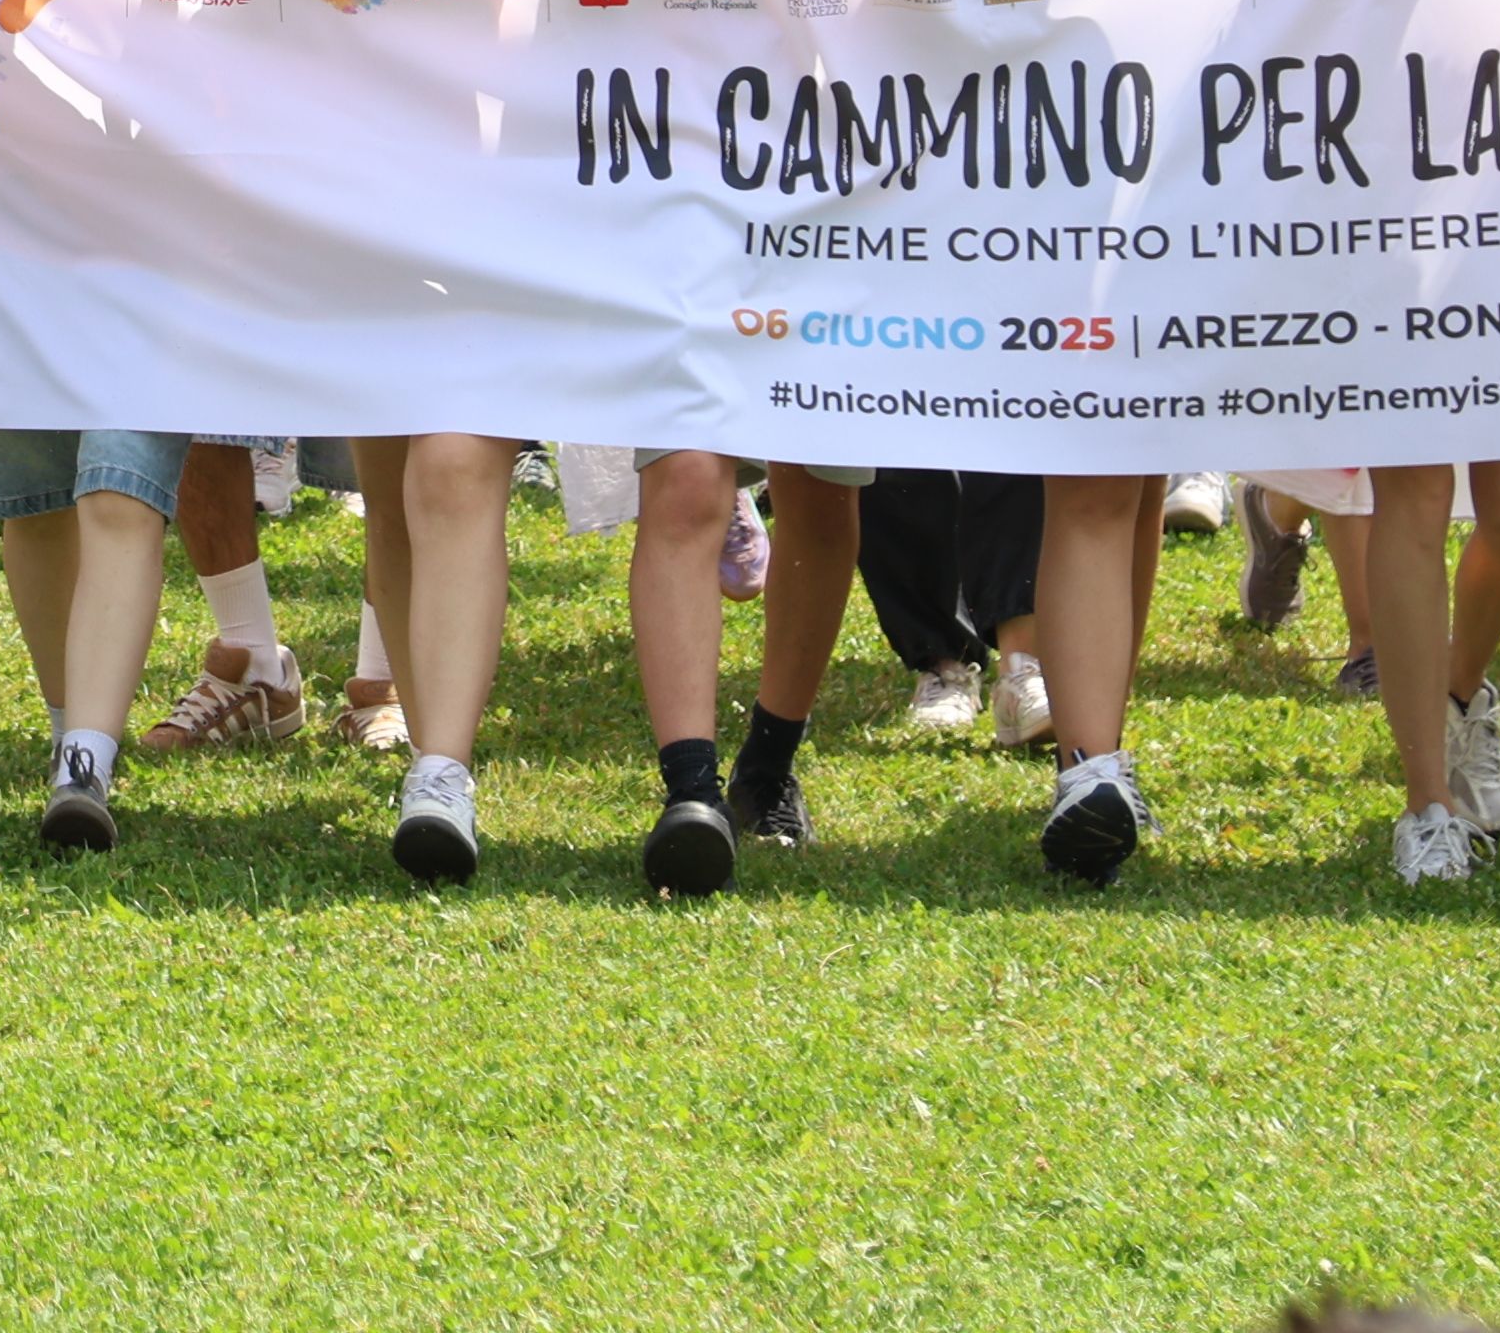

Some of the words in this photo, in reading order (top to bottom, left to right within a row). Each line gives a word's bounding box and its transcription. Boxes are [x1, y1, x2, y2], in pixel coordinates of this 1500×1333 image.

[664, 0, 709, 12] Consiglio
[710, 0, 759, 11] Regionale
[803, 3, 849, 19] AREZZO
[576, 67, 673, 186] IN
[717, 60, 1155, 197] CAMMINO
[1201, 52, 1371, 188] PER
[744, 221, 930, 262] INSIEME
[947, 224, 1172, 262] CONTRO
[731, 308, 789, 341] 06
[799, 309, 986, 351] GIUGNO
[1000, 316, 1117, 351] 2025
[1157, 309, 1359, 351] AREZZO
[768, 380, 1207, 420] #UnicoNemicoèGuerra
